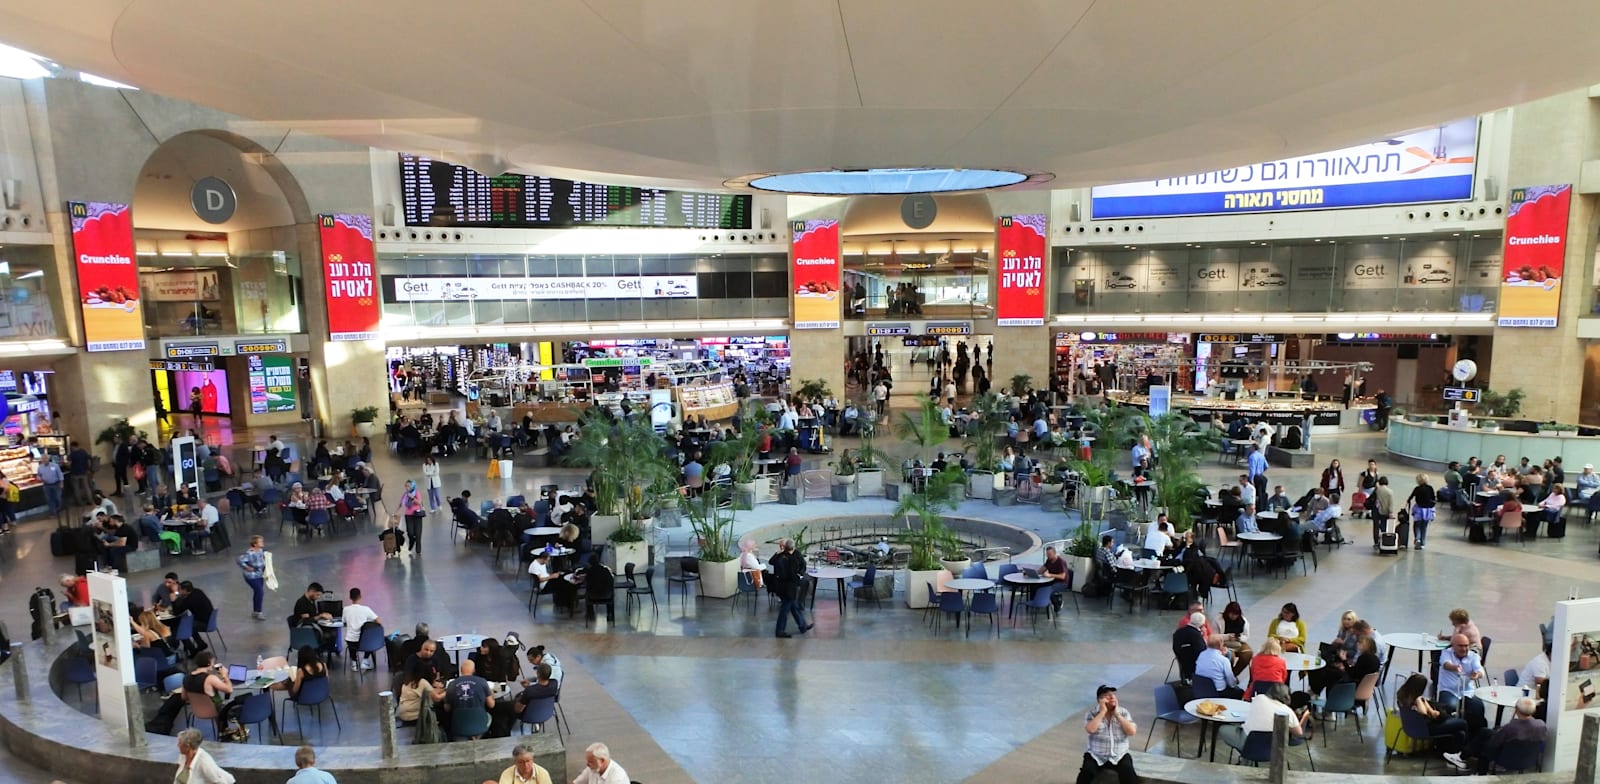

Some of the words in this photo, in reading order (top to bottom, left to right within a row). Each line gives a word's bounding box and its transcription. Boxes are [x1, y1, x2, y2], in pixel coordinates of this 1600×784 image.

[1261, 162, 1288, 181] גם
[1297, 153, 1400, 178] תתאווררו
[207, 190, 225, 211] D
[1224, 191, 1274, 209] תאורה
[1276, 188, 1324, 206] מחסני
[913, 201, 924, 218] E
[1509, 235, 1560, 245] Crunchies
[80, 254, 131, 264] Crunchies
[796, 257, 835, 265] Crunchies
[1003, 270, 1041, 288] לאסיה
[1198, 268, 1226, 279] Gett
[1355, 265, 1385, 276] Gett
[331, 278, 373, 297] לאסיה
[403, 282, 428, 292] Gett
[617, 280, 641, 289] Gett
